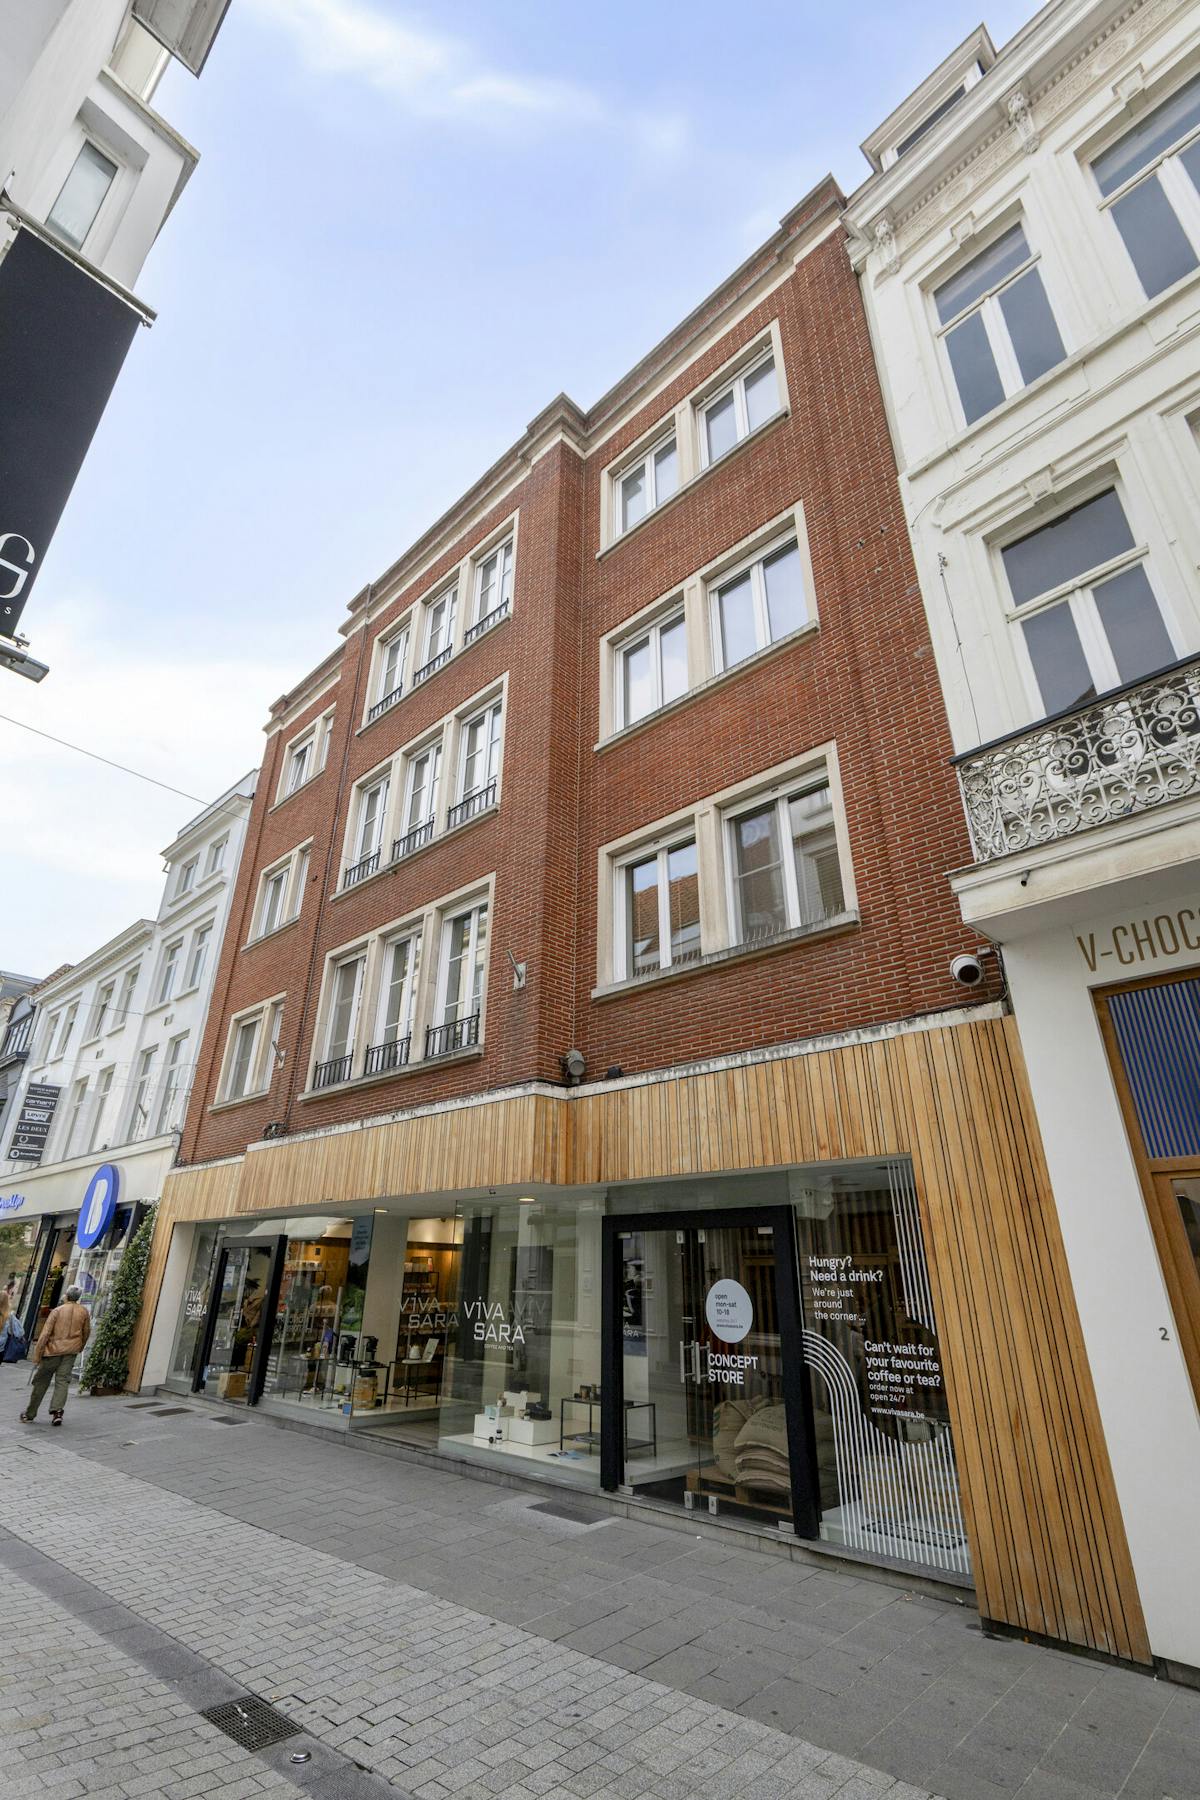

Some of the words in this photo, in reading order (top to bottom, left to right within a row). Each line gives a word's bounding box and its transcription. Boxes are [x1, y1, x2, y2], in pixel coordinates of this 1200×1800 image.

[1076, 908, 1200, 972] V-CHOC
[30, 1125, 48, 1133] DEUX
[808, 1255, 853, 1270] Hungry?
[810, 1270, 838, 1282] Need
[839, 1272, 847, 1282] a
[848, 1269, 883, 1282] drink?
[812, 1287, 836, 1297] We're
[837, 1287, 854, 1299] just
[185, 1303, 207, 1317] SARA
[813, 1299, 843, 1309] around
[716, 1308, 730, 1316] 10-18
[814, 1310, 829, 1320] the
[407, 1313, 459, 1330] SARA
[473, 1322, 526, 1345] SARA
[1158, 1326, 1170, 1341] 2
[864, 1340, 892, 1354] Can't
[892, 1343, 918, 1355] wait
[917, 1343, 935, 1357] for
[708, 1353, 758, 1370] CONCEPT
[865, 1356, 890, 1369] your
[890, 1356, 940, 1372] favourite
[708, 1368, 745, 1385] STORE
[867, 1370, 901, 1383] coffee
[903, 1374, 916, 1385] or
[916, 1373, 941, 1387] tea?
[869, 1383, 889, 1391] order
[905, 1386, 915, 1395] at
[870, 1393, 889, 1402] open
[889, 1394, 906, 1403] 24/7
[871, 1406, 926, 1420] www.vivasara.be
